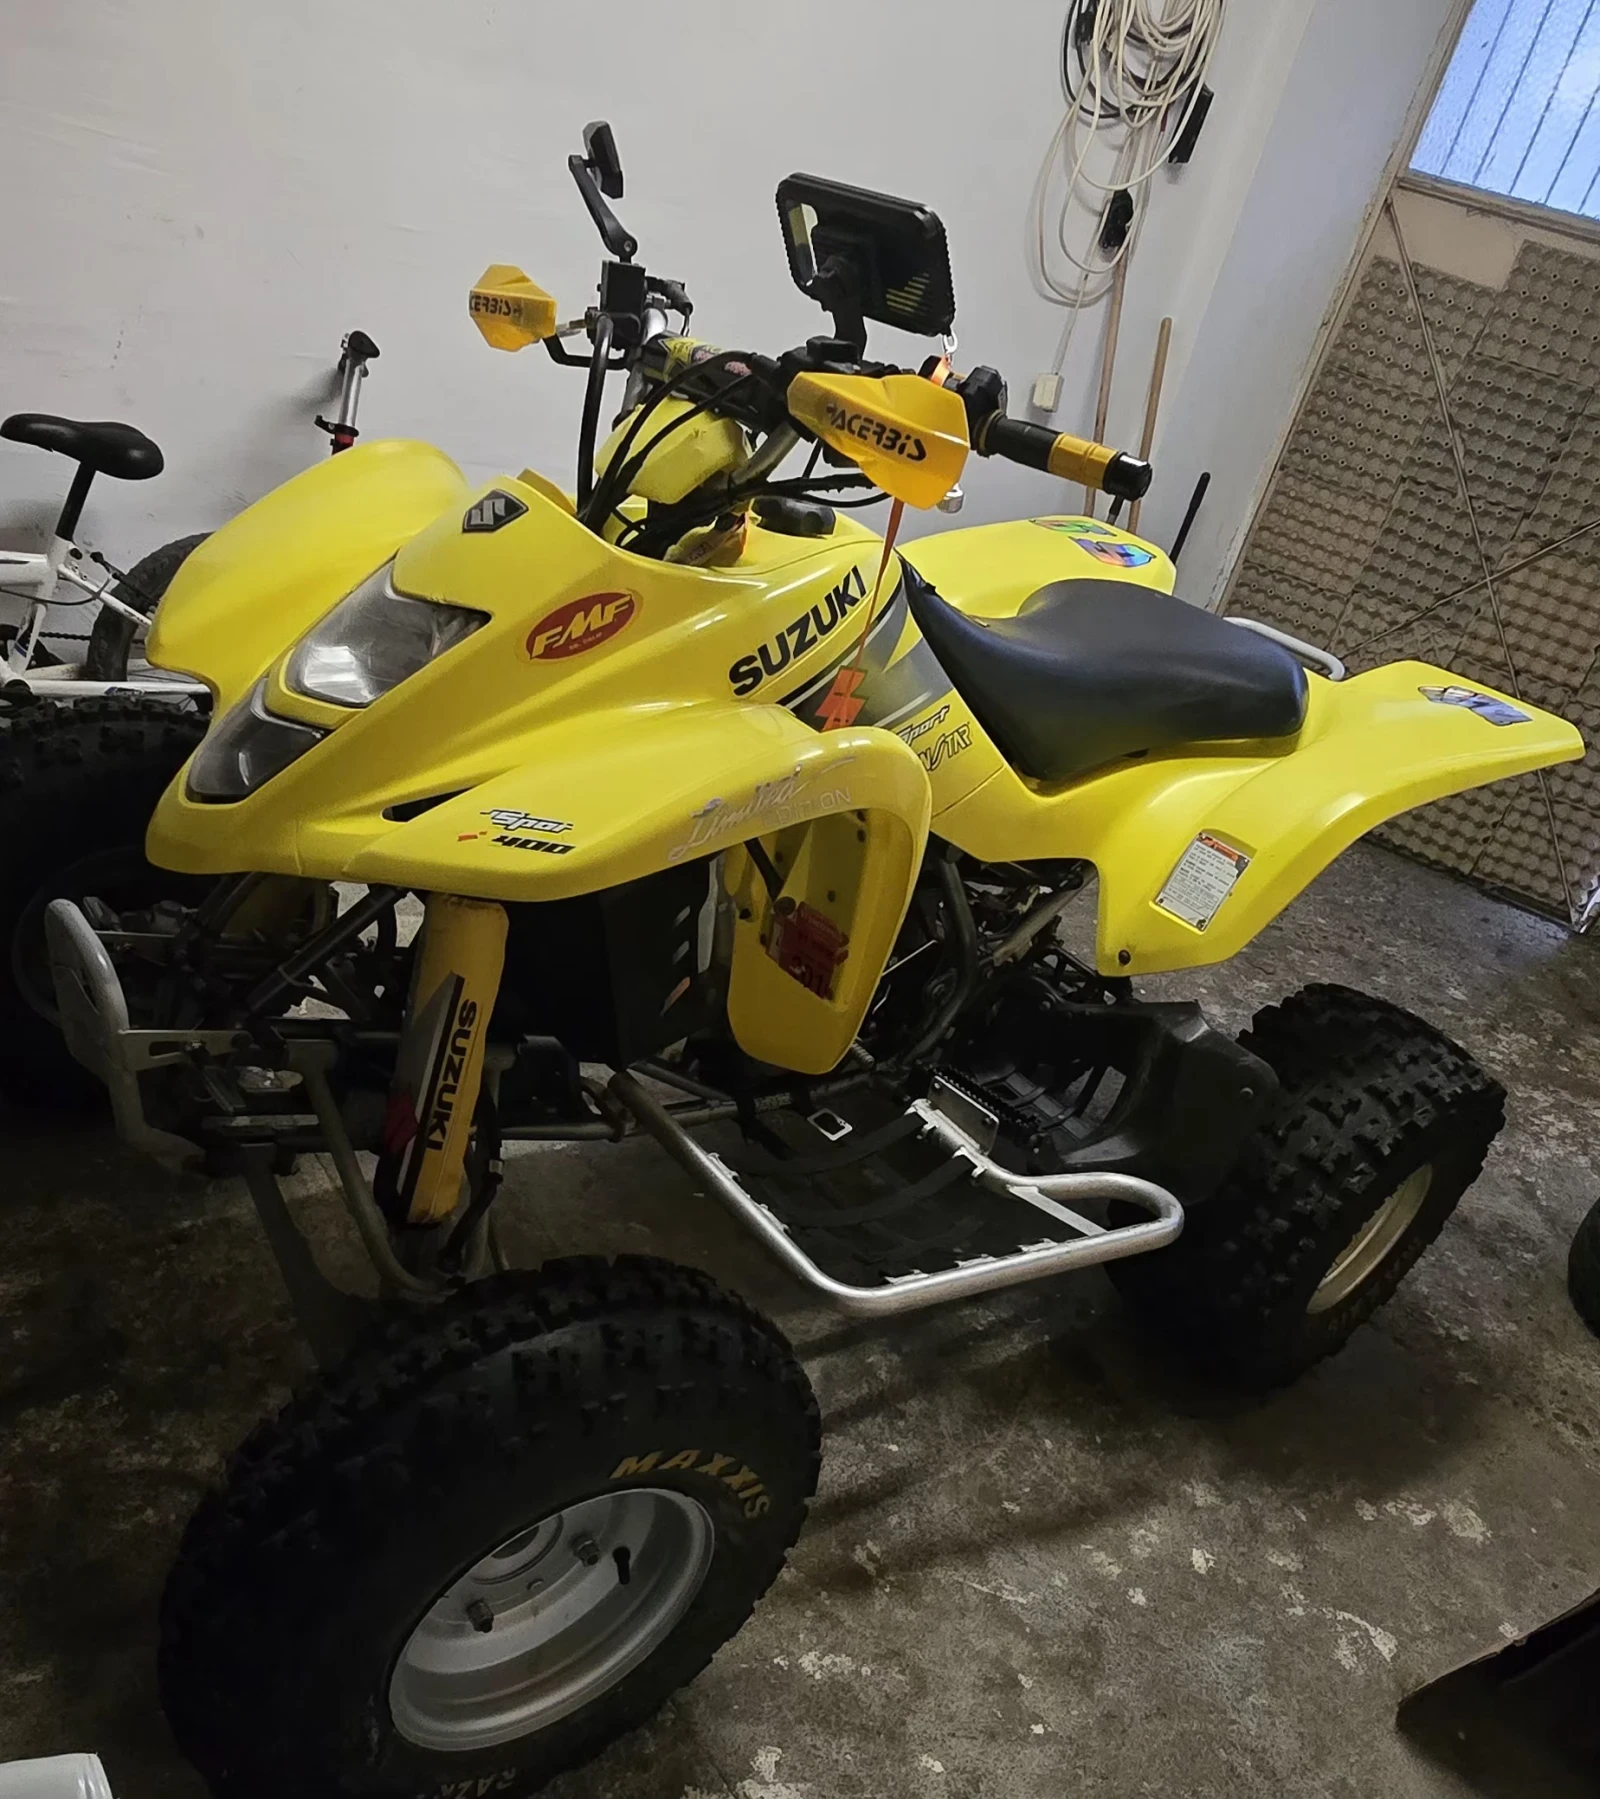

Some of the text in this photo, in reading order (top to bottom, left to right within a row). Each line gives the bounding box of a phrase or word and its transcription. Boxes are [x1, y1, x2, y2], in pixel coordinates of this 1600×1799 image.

[531, 595, 632, 658] FMF
[729, 565, 867, 696] SUZUKI
[426, 999, 478, 1151] SUZUKI
[609, 1449, 771, 1519] MAXXIS
